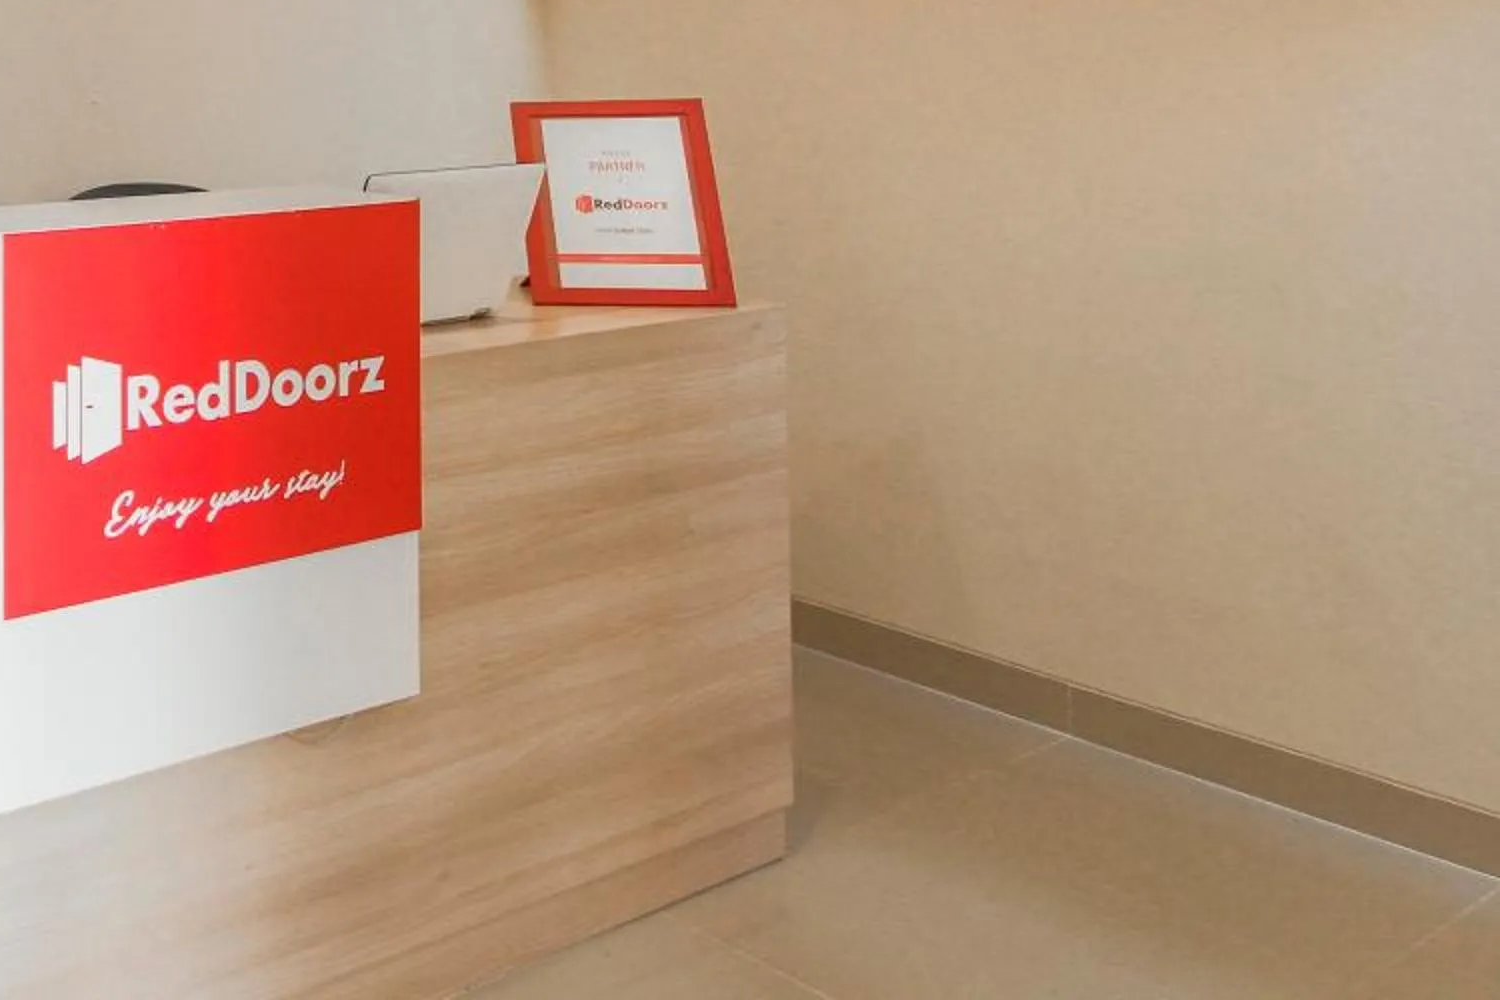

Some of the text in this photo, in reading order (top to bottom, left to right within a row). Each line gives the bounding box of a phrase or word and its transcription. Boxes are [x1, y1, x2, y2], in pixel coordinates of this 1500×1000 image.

[126, 356, 385, 431] RedDoorz
[104, 459, 345, 538] Enjoy your stay!
